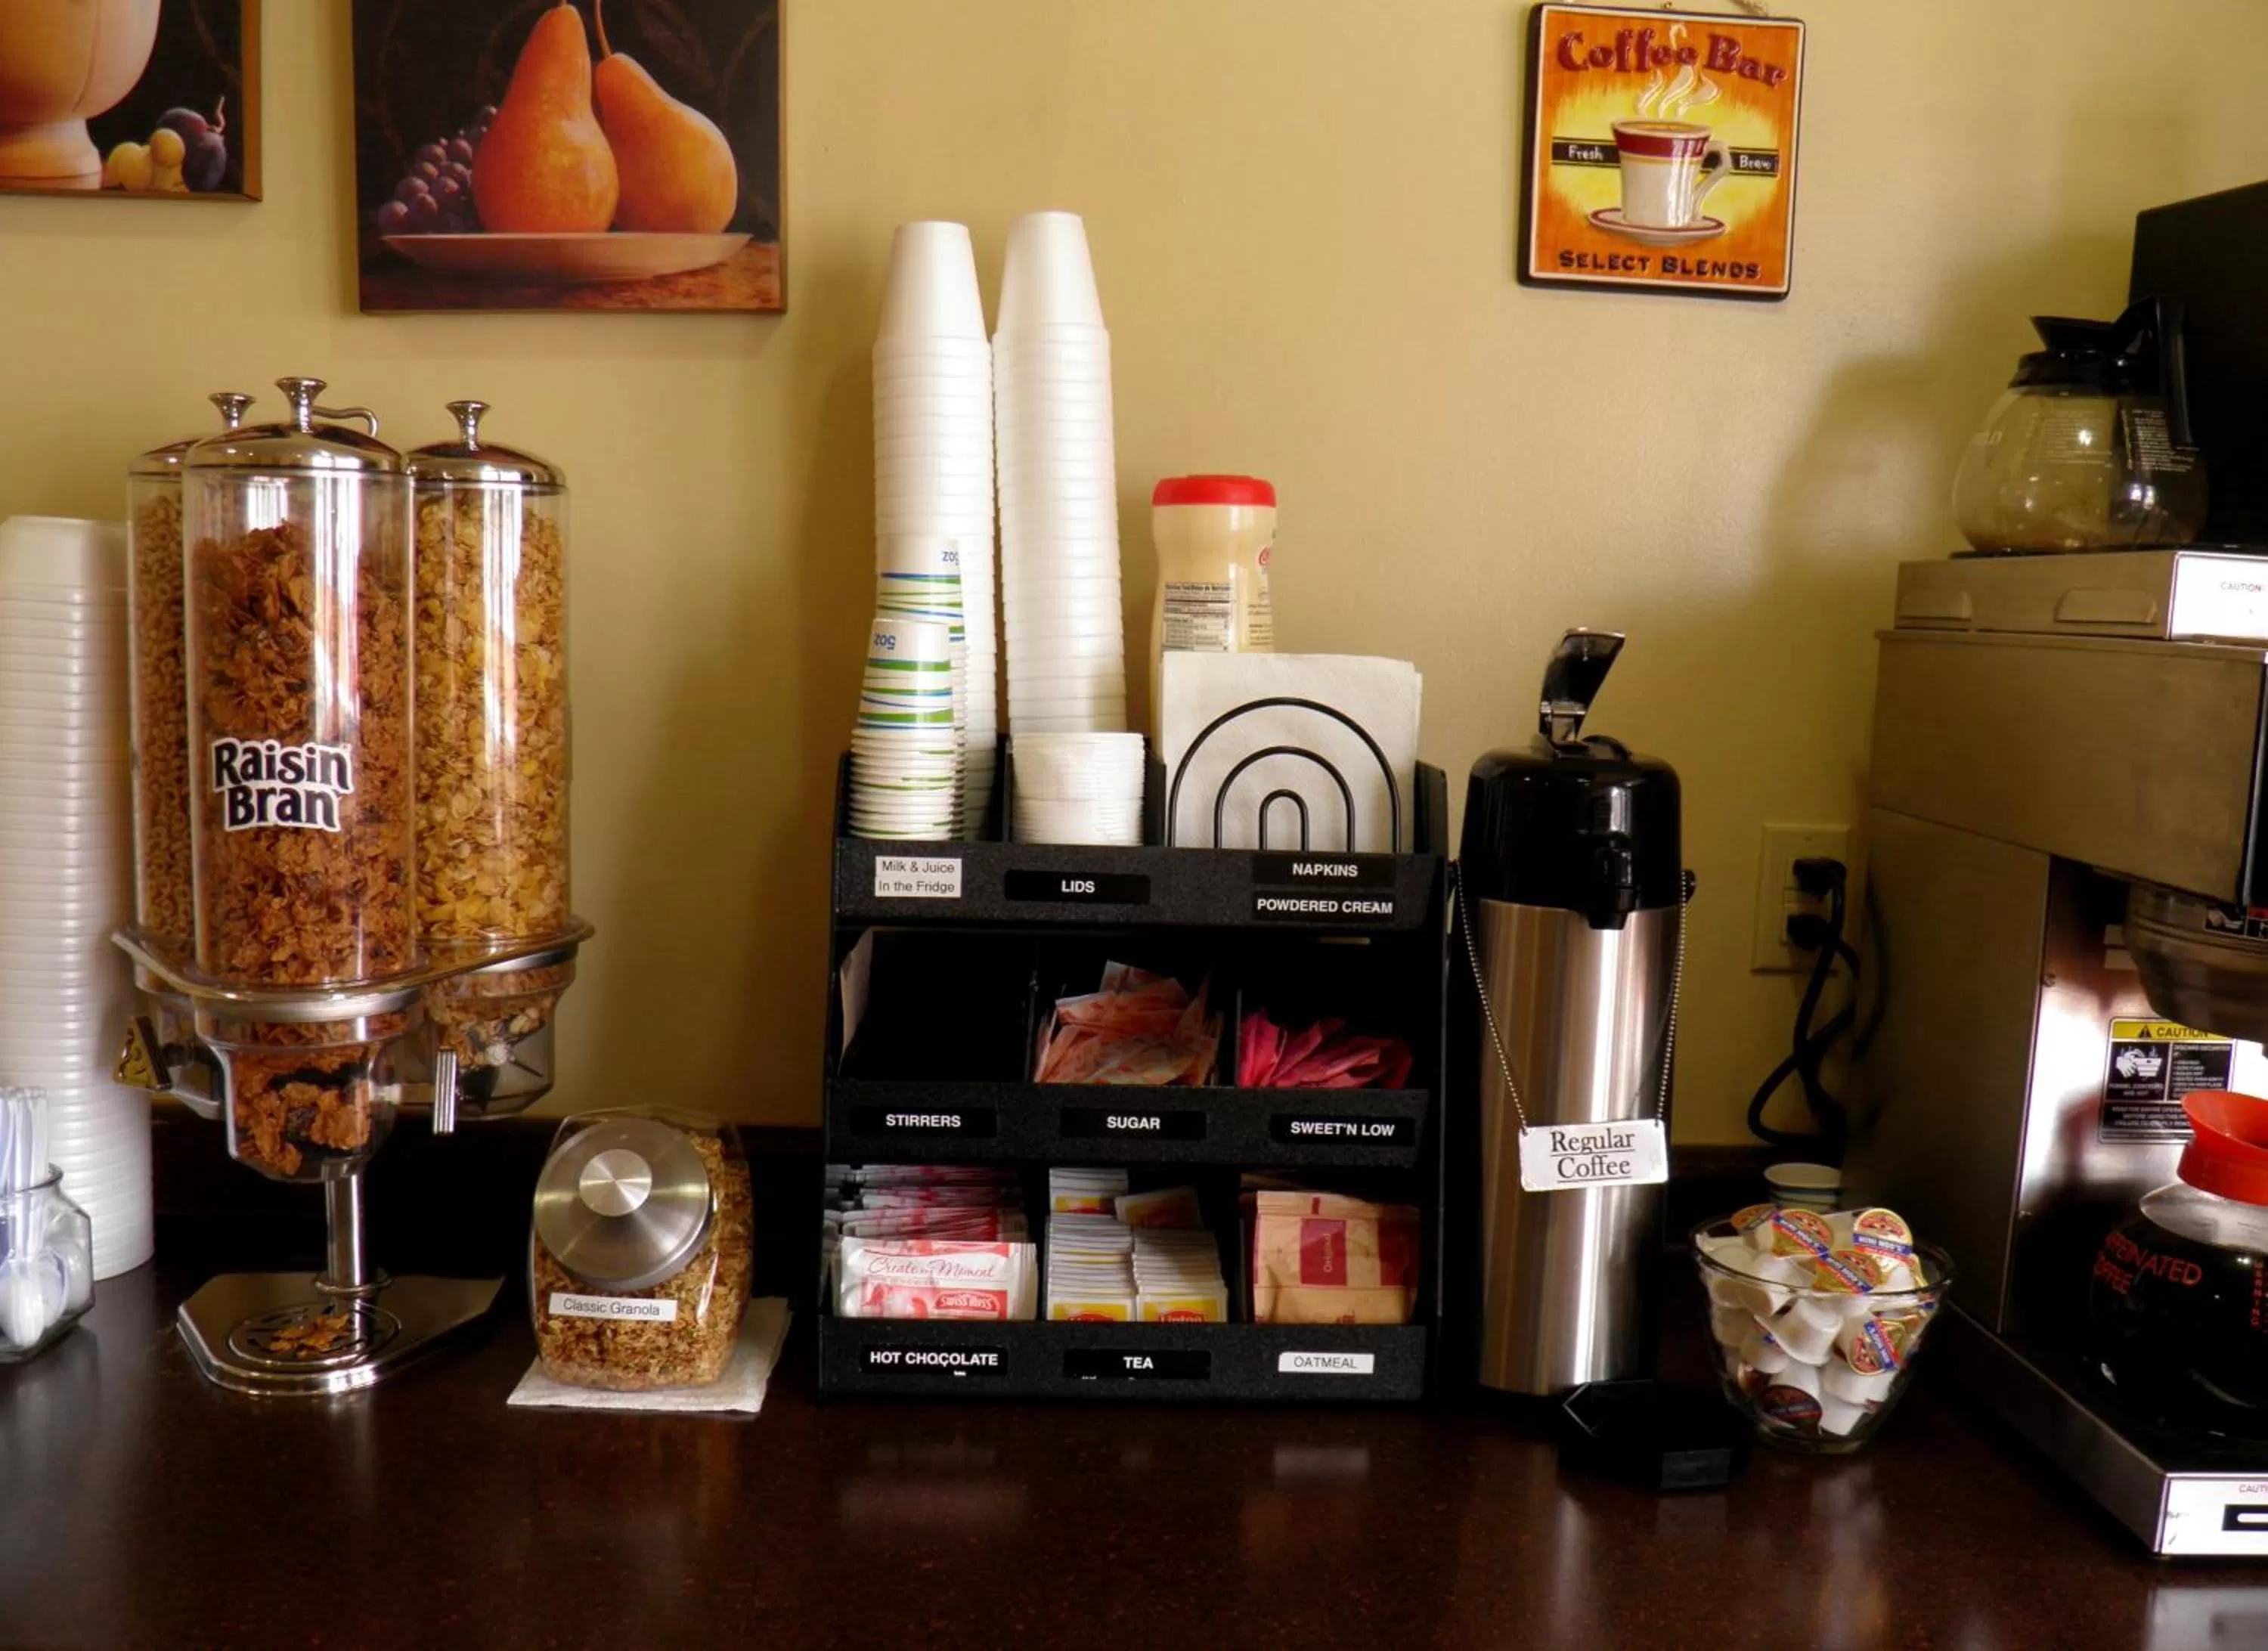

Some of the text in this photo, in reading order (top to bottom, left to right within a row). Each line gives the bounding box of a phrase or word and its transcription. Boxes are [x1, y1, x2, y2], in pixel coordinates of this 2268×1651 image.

[1557, 27, 1787, 88] Coffee Bar
[1569, 144, 1772, 169] Fresh Brew
[1559, 249, 1761, 279] SELECT BLENDS
[2220, 581, 2262, 592] CAUTION
[212, 739, 352, 792] Raisin
[226, 784, 339, 830] Bran
[881, 860, 955, 872] Milk & Juice
[1292, 863, 1359, 878] NAPKINS
[878, 880, 955, 895] In the Fridge
[1061, 880, 1095, 893] LIDS
[1257, 898, 1393, 914] POWDERED CREAM
[885, 1114, 961, 1128] STIRRERS
[1106, 1116, 1160, 1129] SUGAR
[1290, 1121, 1395, 1136] SWEET'N LOW
[1550, 1127, 1634, 1155] Regular
[1557, 1154, 1631, 1179] Coffee
[563, 1297, 660, 1316] Classic Granola
[869, 1352, 999, 1366] HOT CHOCOLATE
[1123, 1357, 1154, 1369] TEA
[1294, 1355, 1358, 1370] OATMEAL
